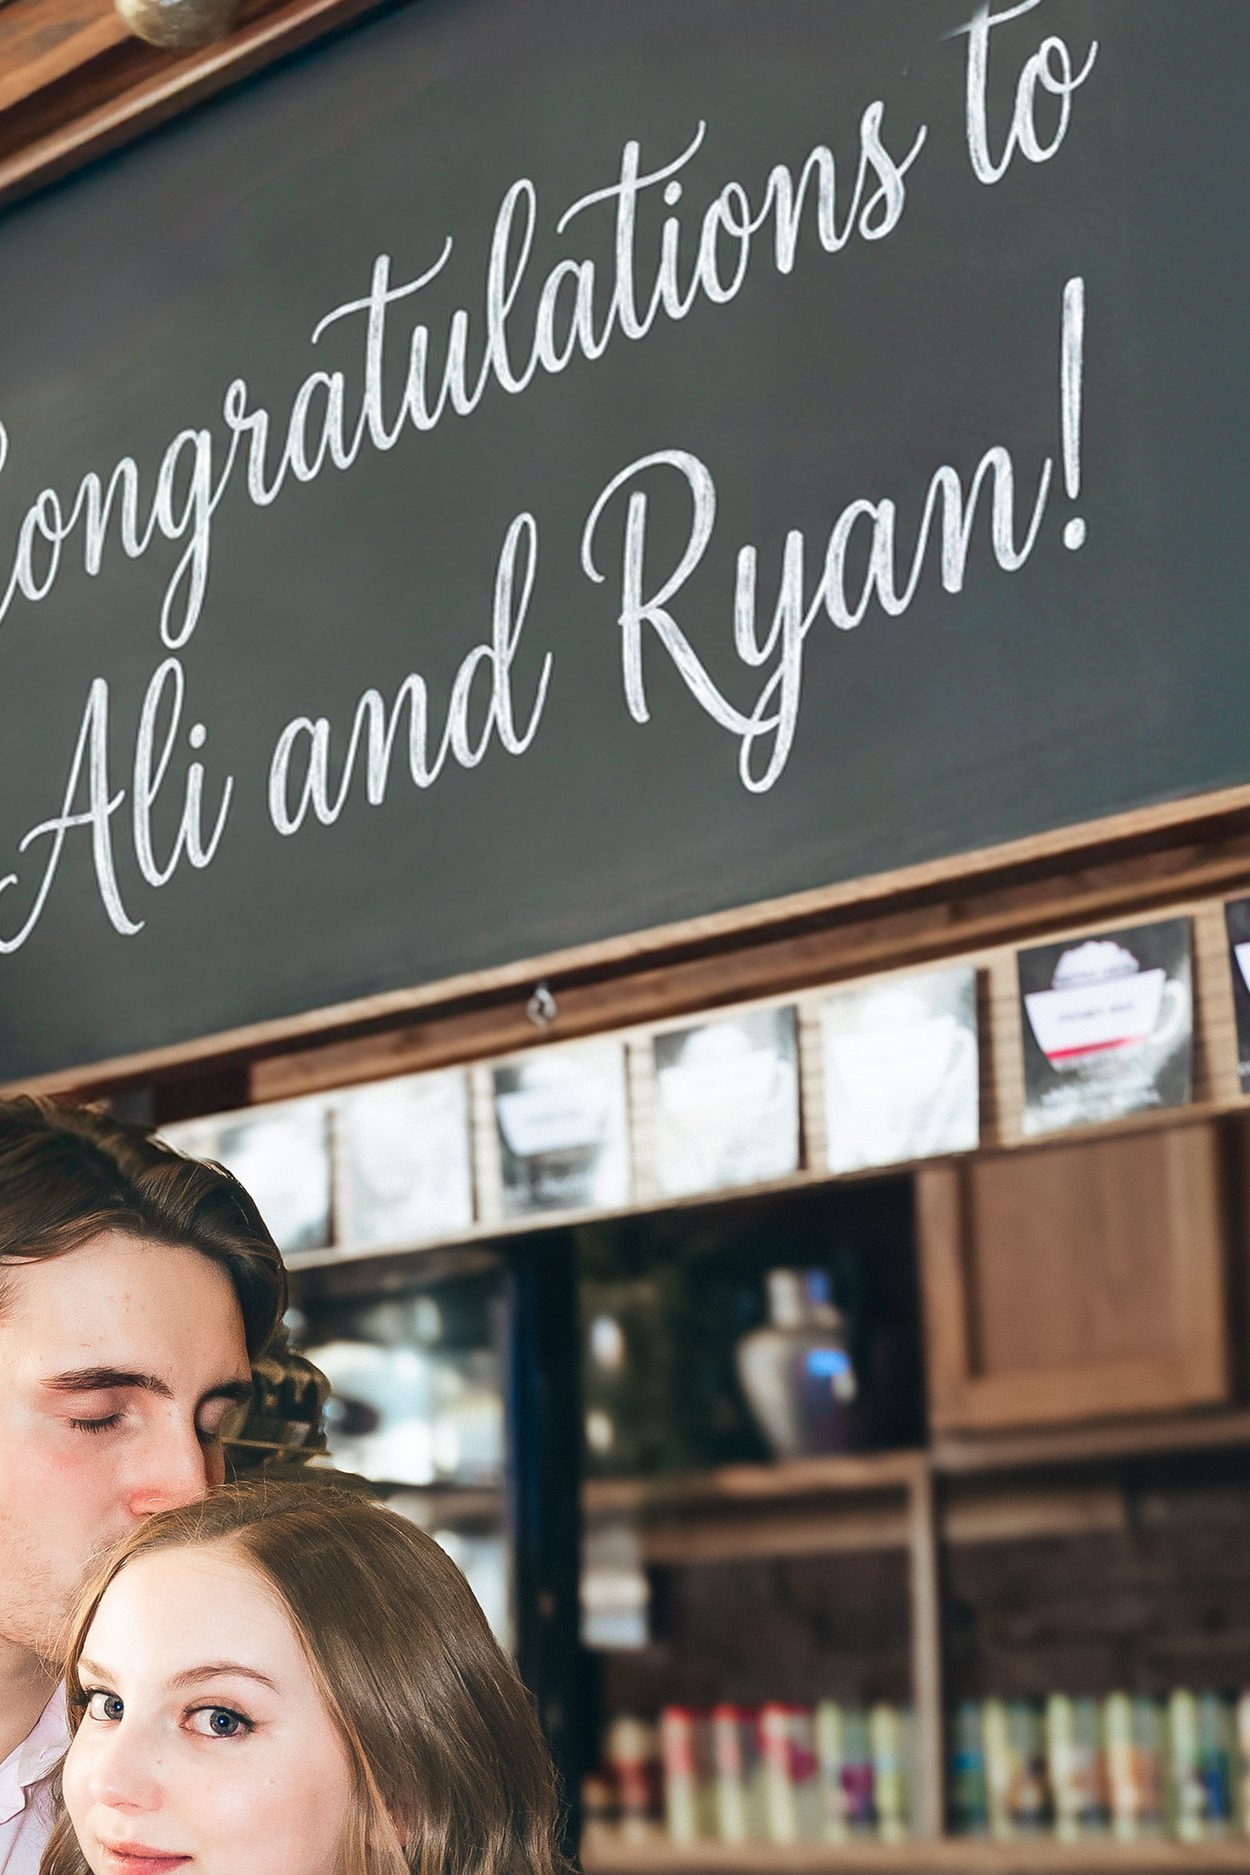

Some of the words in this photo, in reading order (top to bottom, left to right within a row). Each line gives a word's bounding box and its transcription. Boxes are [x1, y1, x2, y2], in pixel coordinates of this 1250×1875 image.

[942, 0, 1100, 185] to
[268, 512, 553, 837] and
[581, 276, 1087, 794] Ryan!
